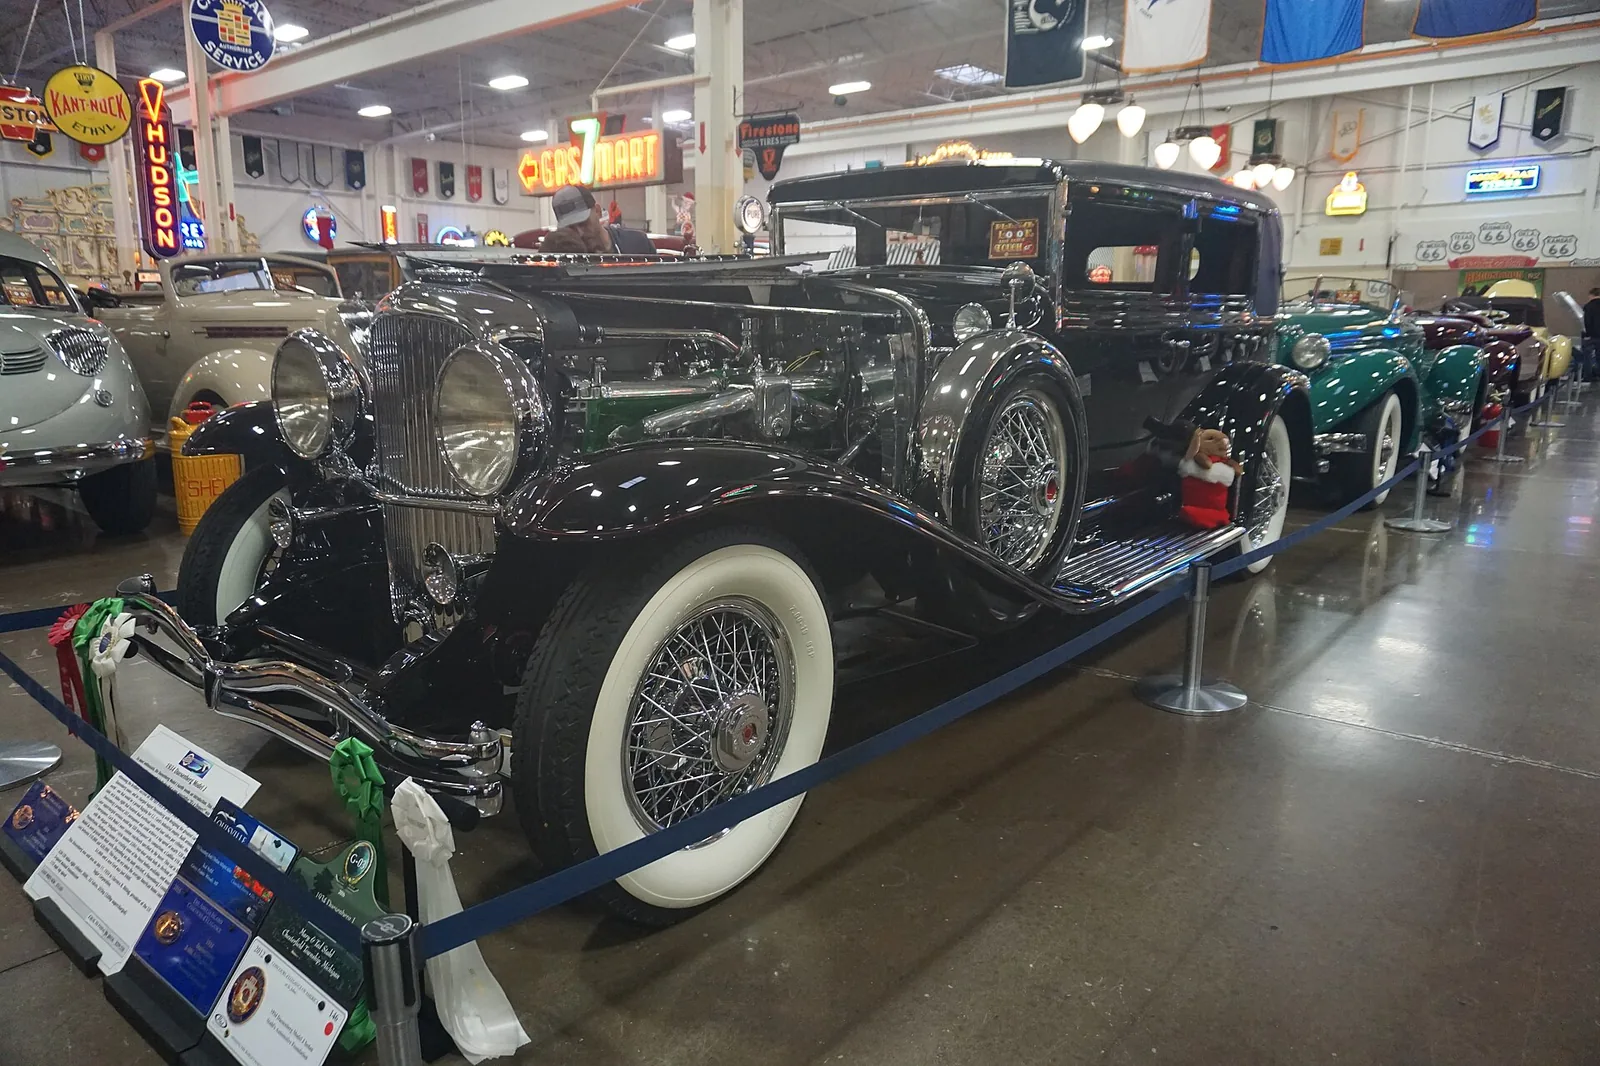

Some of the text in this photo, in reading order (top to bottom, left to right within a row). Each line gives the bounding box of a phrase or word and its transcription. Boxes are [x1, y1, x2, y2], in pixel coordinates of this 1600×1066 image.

[204, 40, 265, 70] SERVICE
[72, 121, 117, 136] ETHYL
[740, 122, 799, 139] Firestone
[760, 136, 780, 146] TIRES
[570, 117, 600, 185] 7
[594, 134, 659, 182] MART
[540, 145, 582, 189] GAS
[146, 122, 176, 249] HUDSON
[1484, 231, 1505, 242] 66
[1516, 238, 1536, 249] 66
[1453, 240, 1472, 251] 66
[1549, 244, 1570, 256] 66
[1422, 248, 1441, 260] 66
[213, 815, 248, 844] LOUISVILLE
[350, 853, 367, 870] G-03
[329, 1010, 338, 1021] 146
